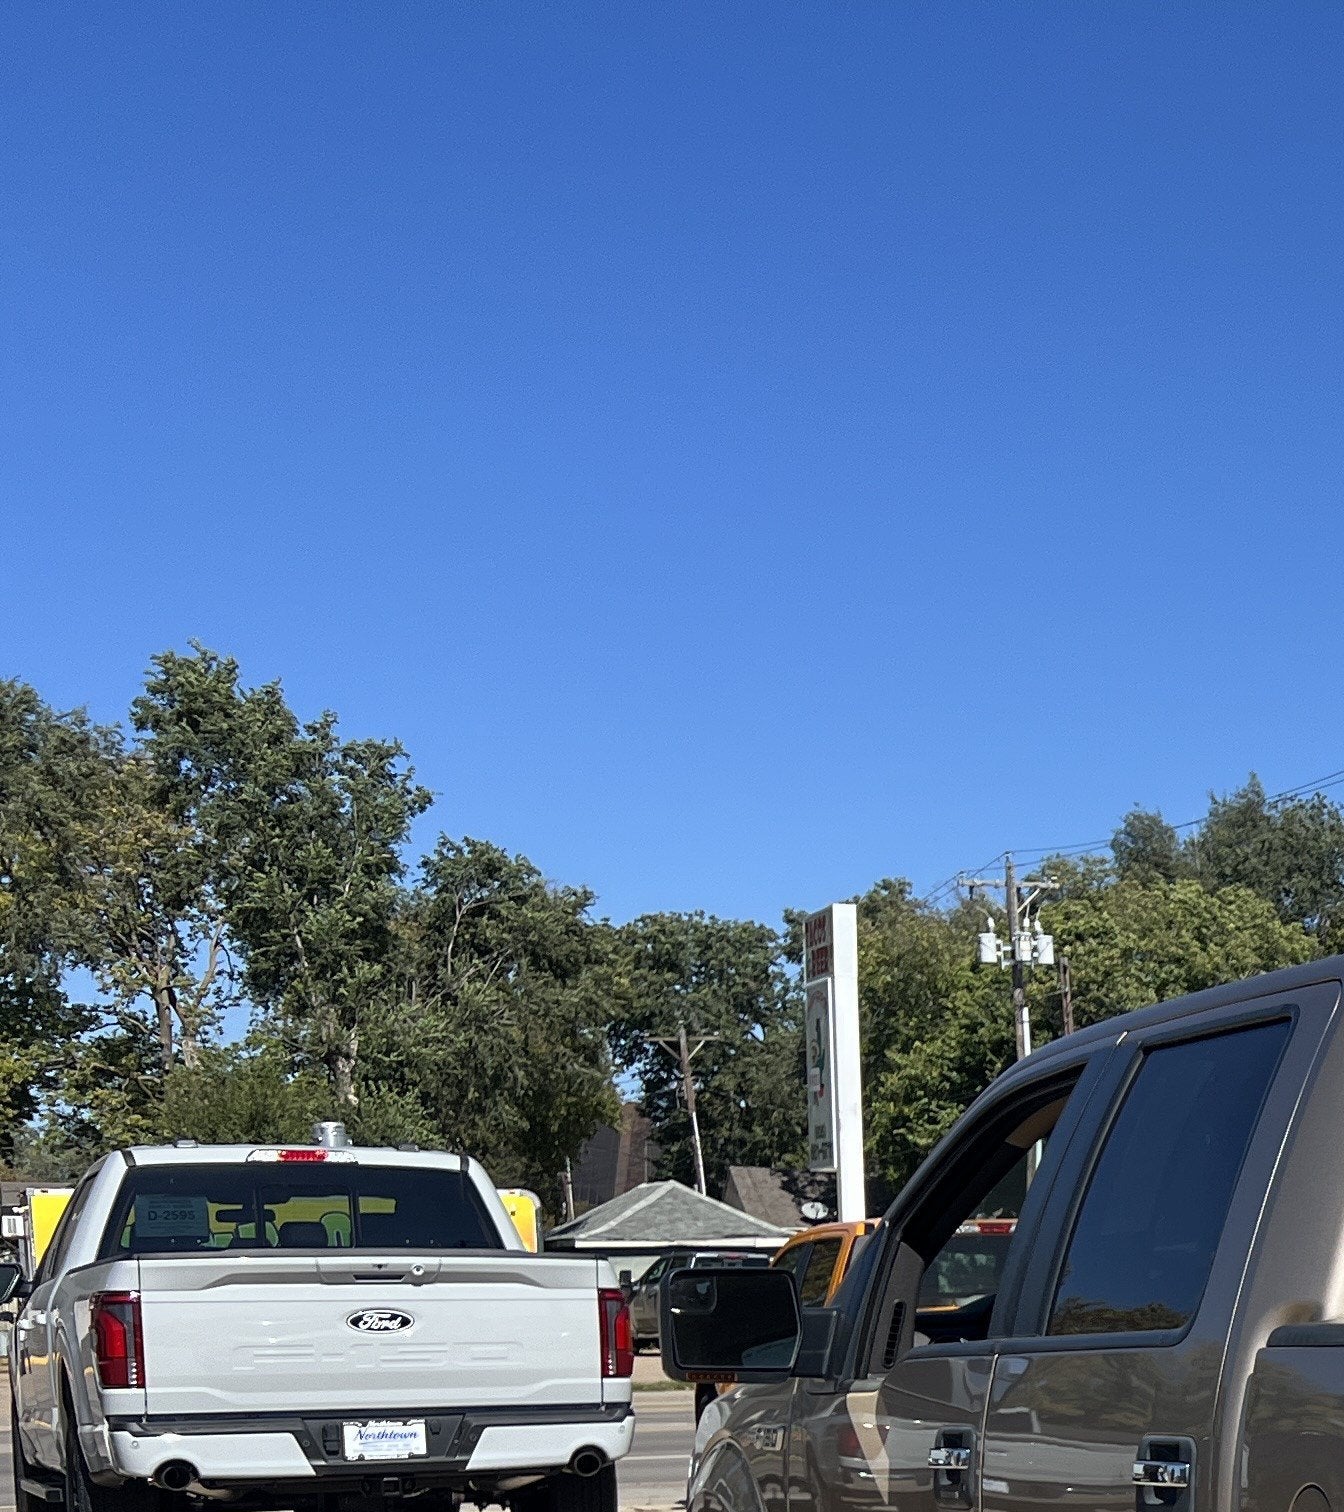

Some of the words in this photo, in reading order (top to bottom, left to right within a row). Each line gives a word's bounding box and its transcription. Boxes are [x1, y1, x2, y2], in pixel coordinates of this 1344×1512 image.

[148, 1210, 196, 1221] D-2595
[358, 1312, 402, 1330] Ford
[353, 1428, 420, 1442] Northtown
